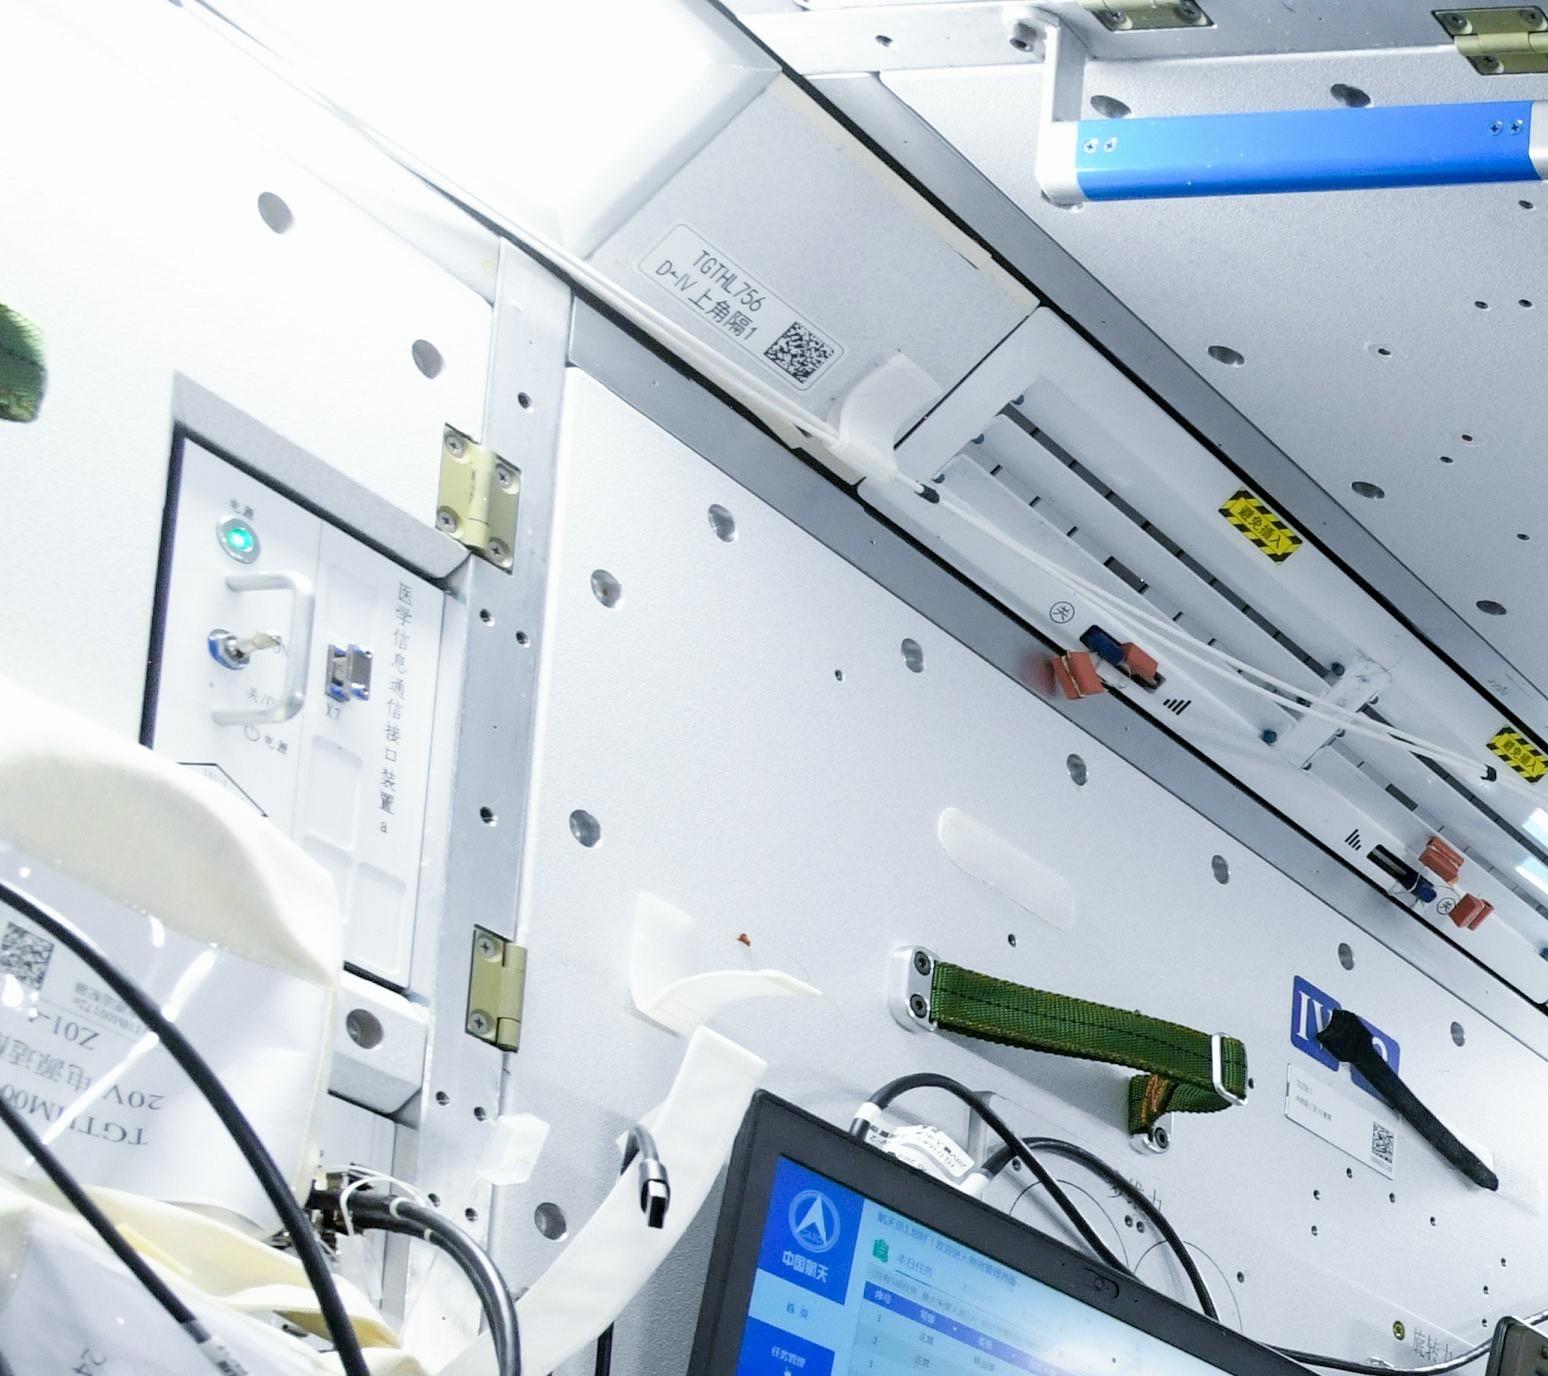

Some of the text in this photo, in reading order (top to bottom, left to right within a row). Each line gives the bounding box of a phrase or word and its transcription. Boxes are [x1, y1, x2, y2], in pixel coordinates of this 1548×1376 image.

[692, 249, 764, 313] TGTHL756
[1238, 504, 1283, 550] 避免插入
[103, 1083, 167, 1112] 20V
[782, 1250, 829, 1284] 中国航天
